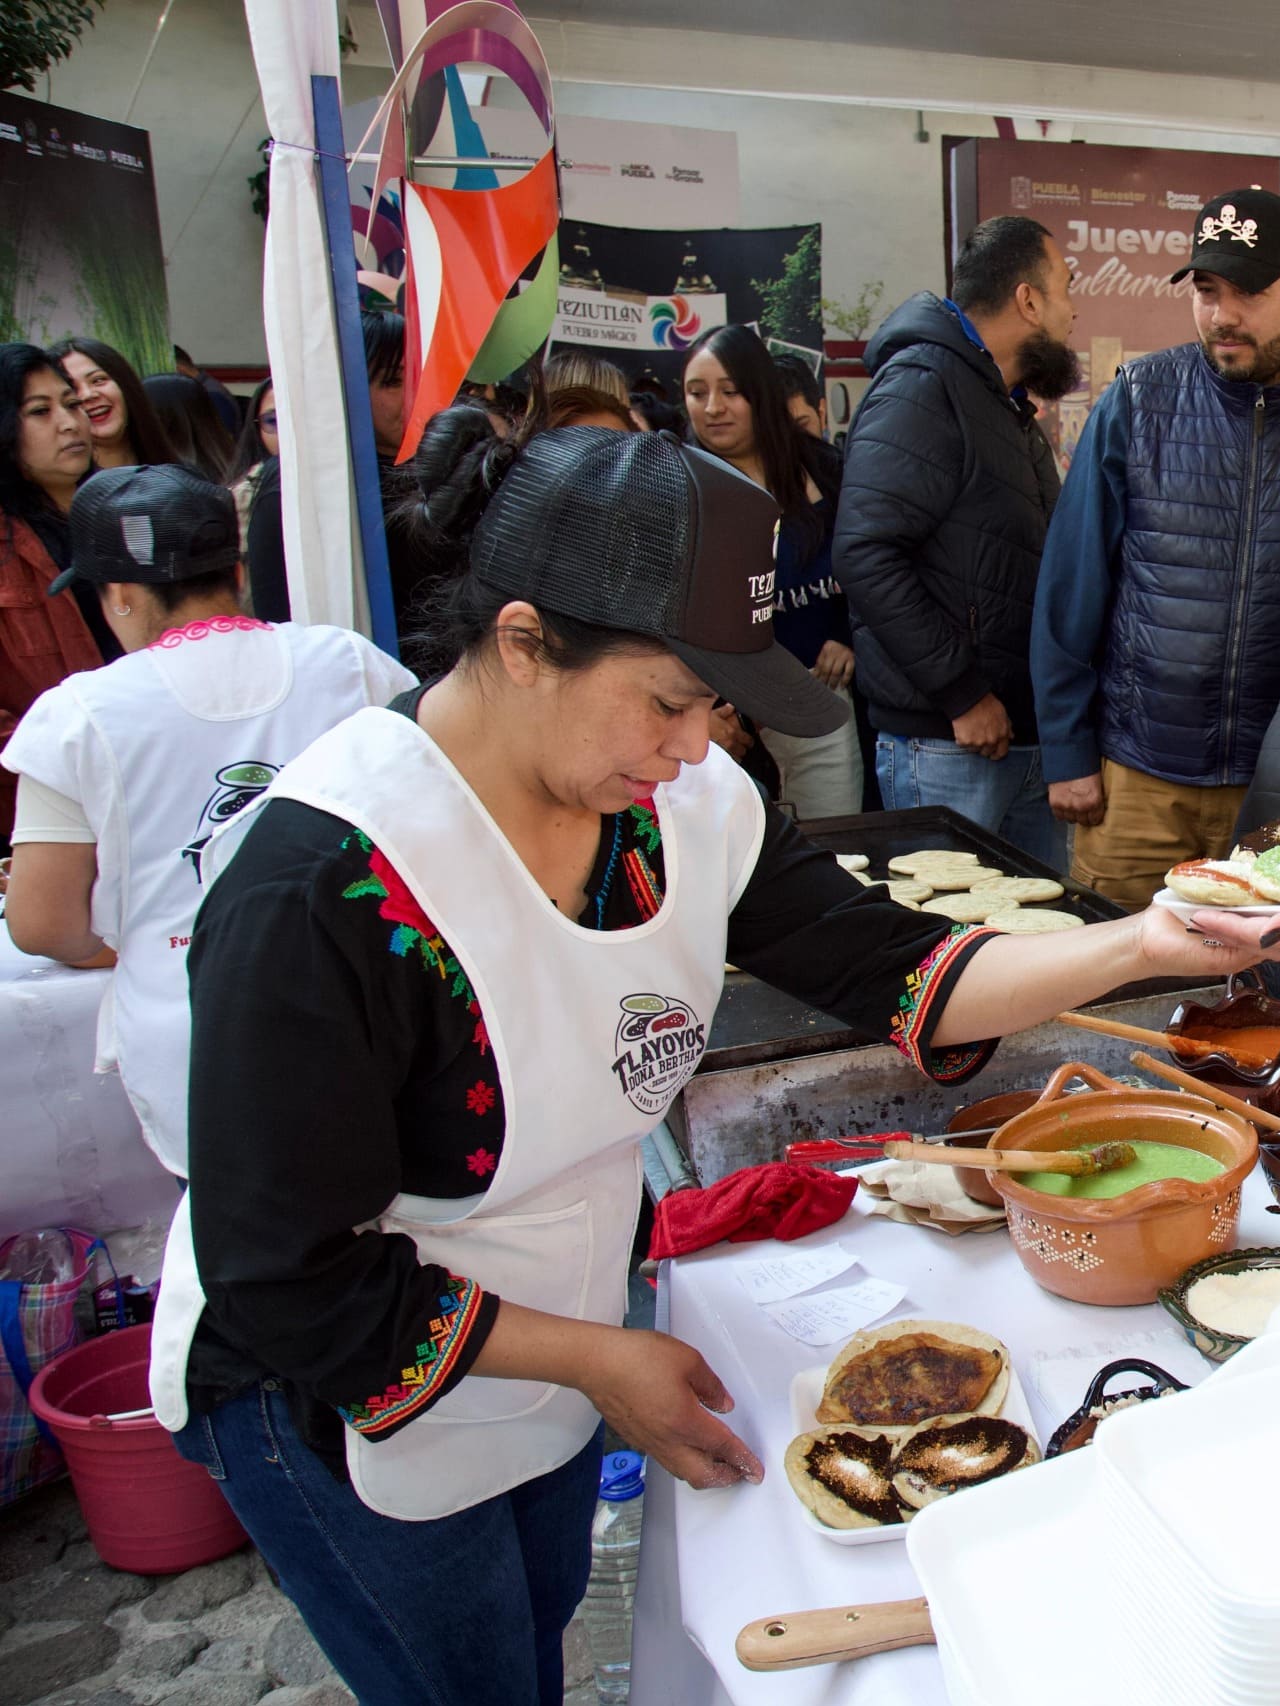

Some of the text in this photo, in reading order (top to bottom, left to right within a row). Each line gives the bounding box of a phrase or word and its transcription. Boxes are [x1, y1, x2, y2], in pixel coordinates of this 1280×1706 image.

[110, 150, 144, 168] PUEBLA
[1032, 183, 1080, 195] PUEBLA
[1091, 188, 1147, 201] Bienestar
[611, 1023, 705, 1095] TLAYOYOS
[628, 1064, 655, 1092] DOÑA
[658, 1049, 696, 1074] BERTHA
